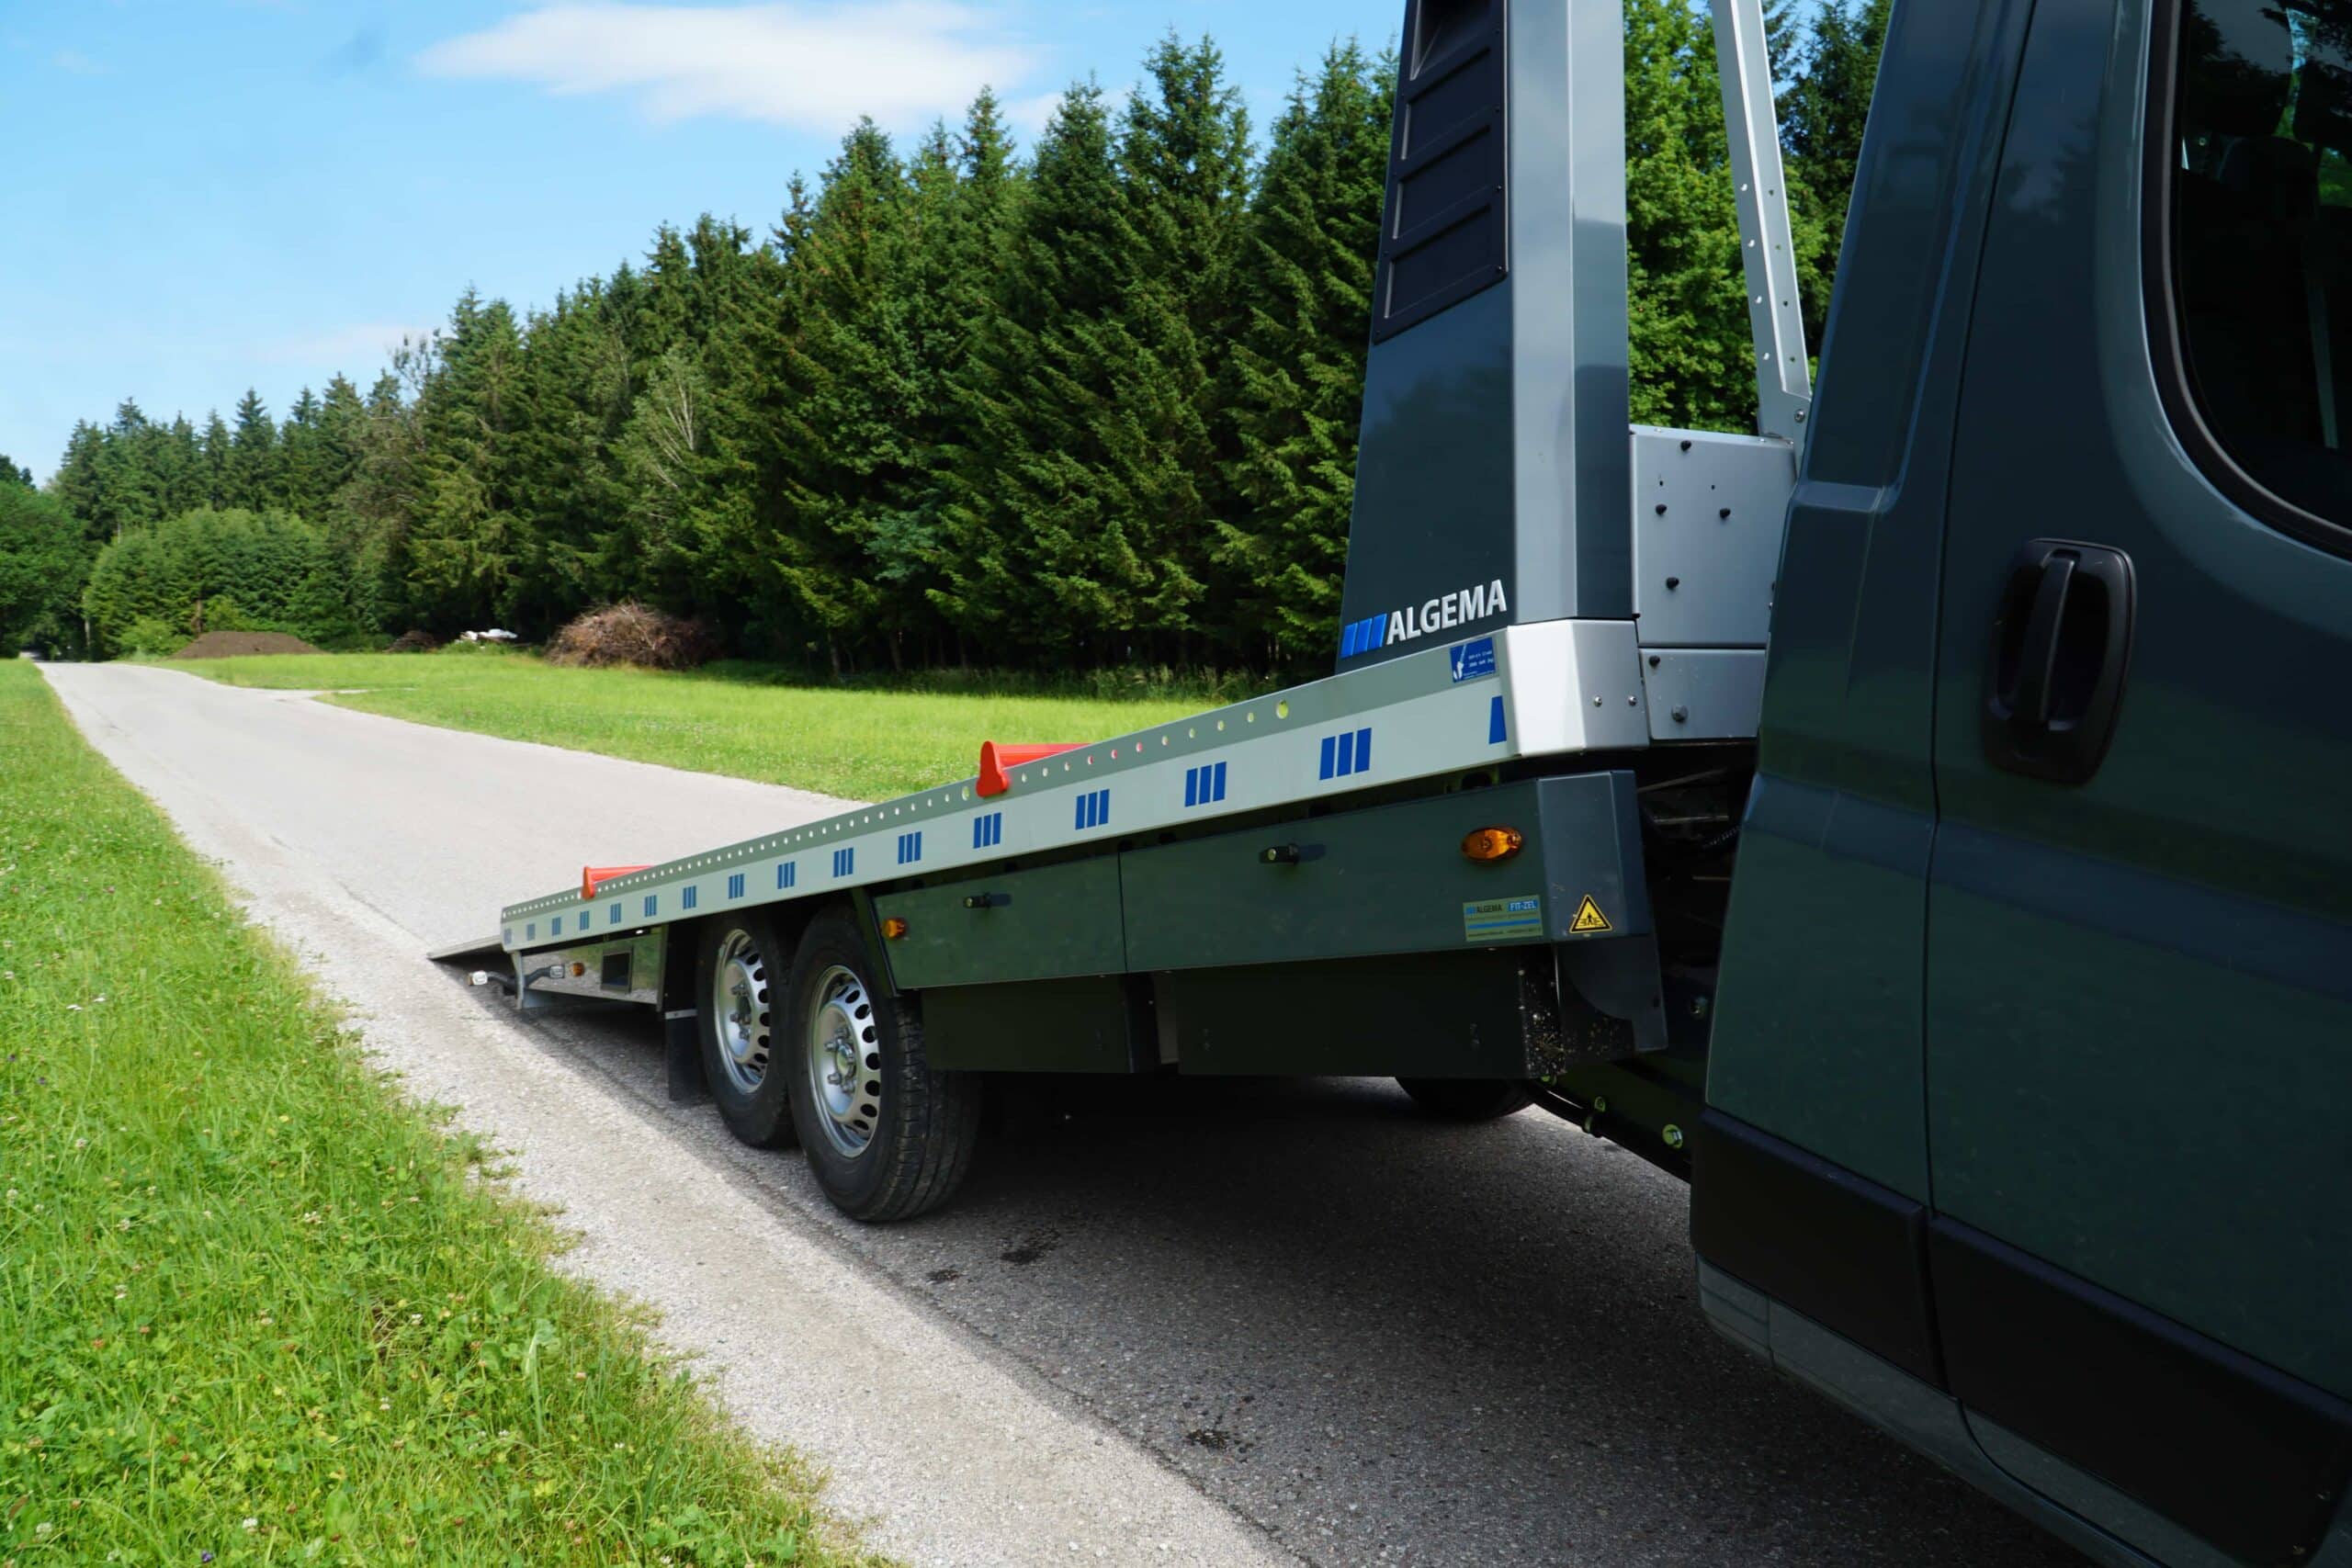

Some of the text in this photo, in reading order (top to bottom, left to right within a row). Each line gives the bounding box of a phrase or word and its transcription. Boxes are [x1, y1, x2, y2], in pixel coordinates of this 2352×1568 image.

[1386, 579, 1507, 645] ALGEMA
[1476, 900, 1536, 913] ALGEMA FIT-ZEL
